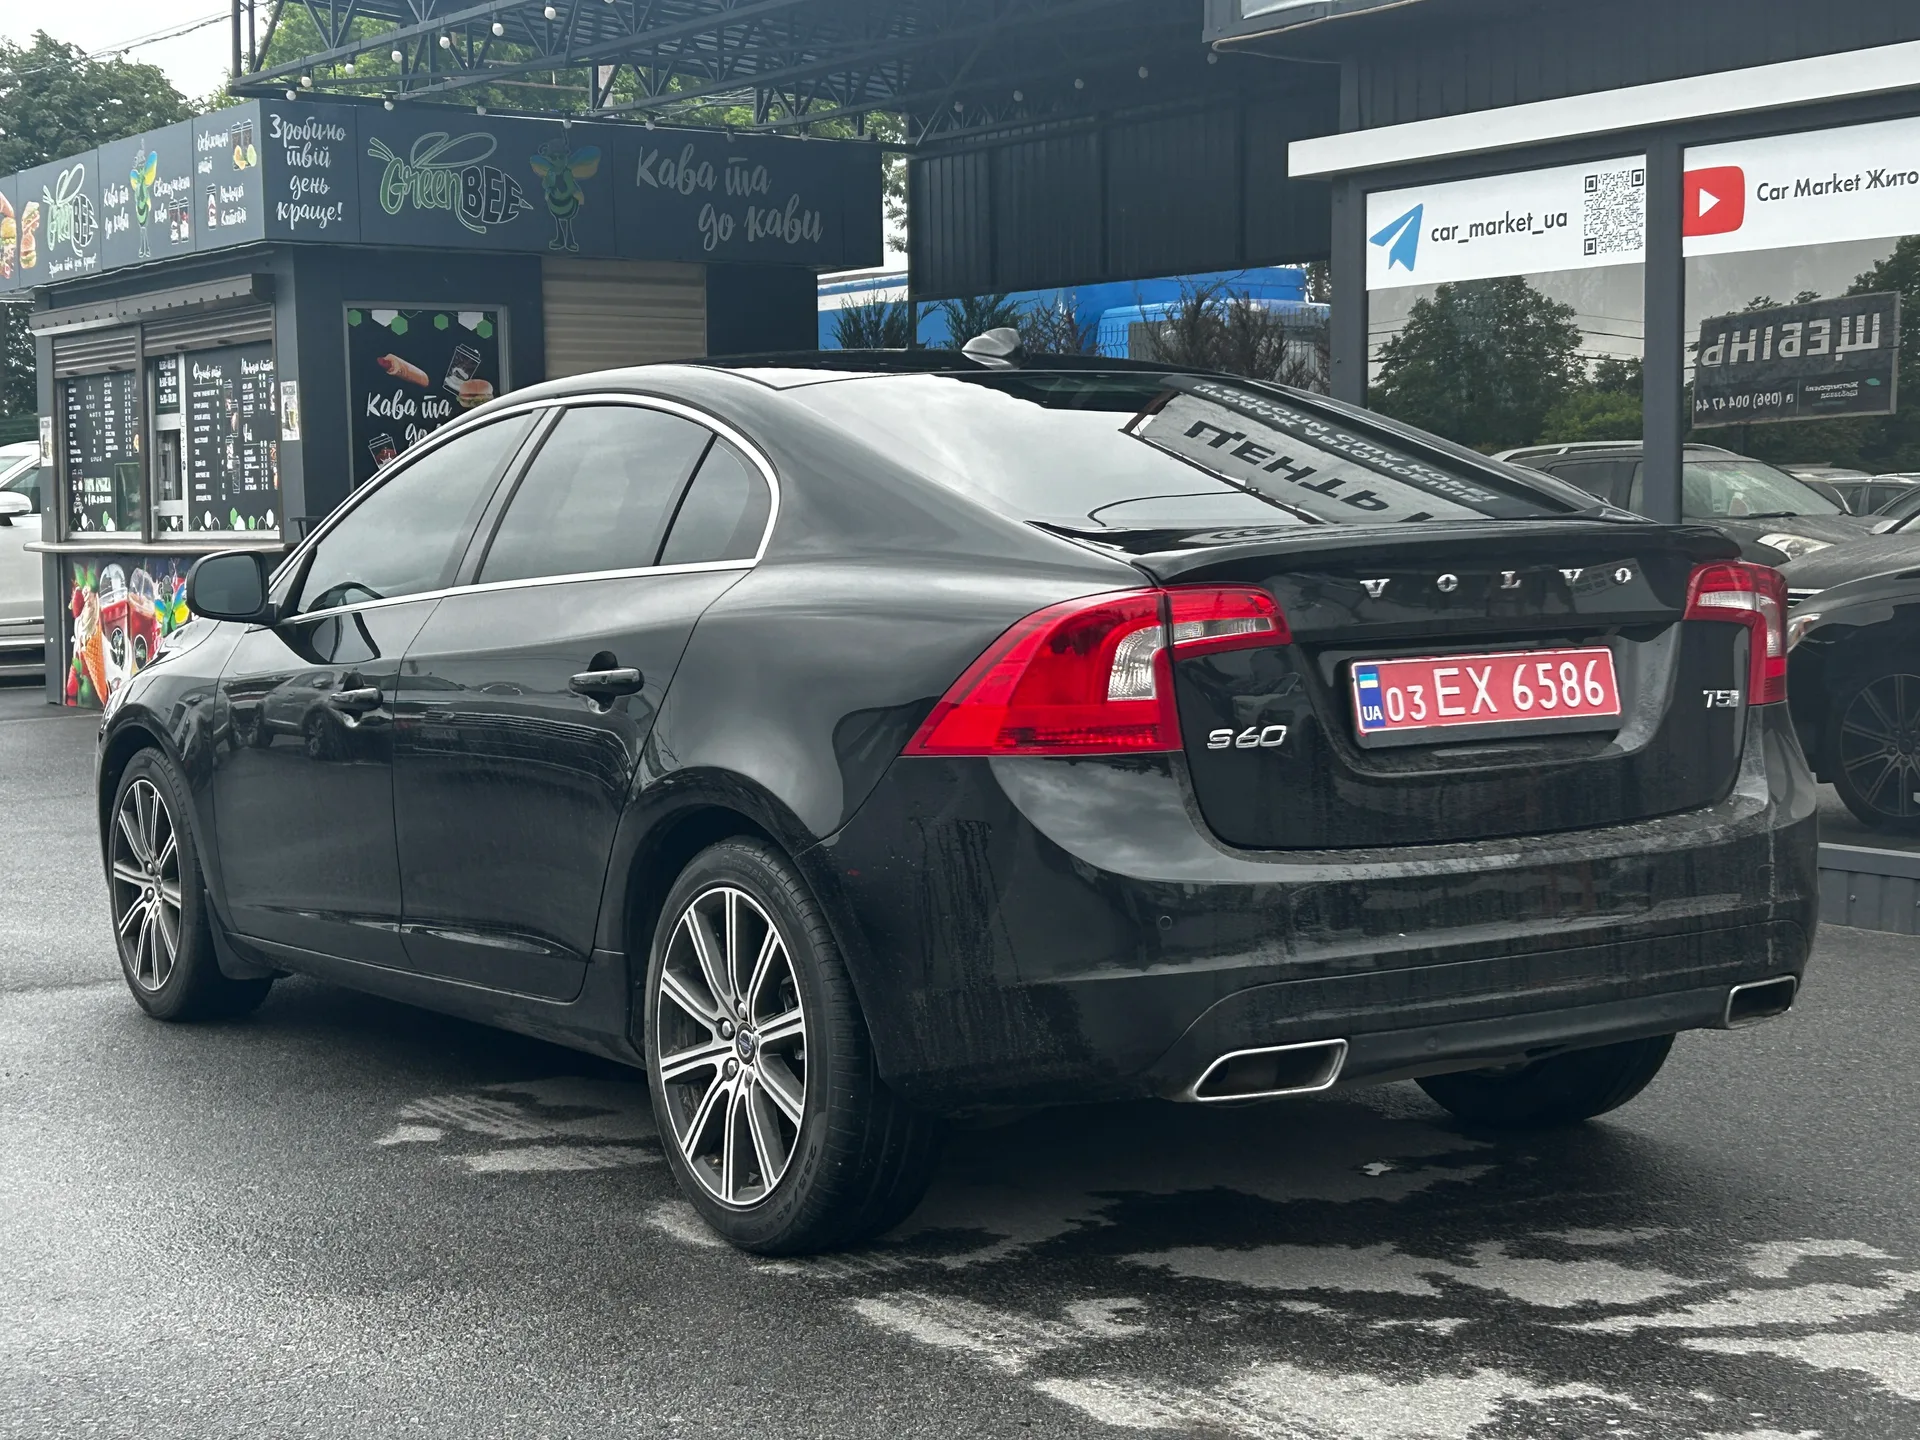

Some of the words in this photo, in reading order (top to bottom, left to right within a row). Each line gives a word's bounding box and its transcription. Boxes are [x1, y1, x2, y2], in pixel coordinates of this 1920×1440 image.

[287, 141, 331, 168] твій
[636, 143, 717, 195] Кава
[724, 157, 772, 197] та
[290, 175, 330, 200] день
[1757, 182, 1789, 202] Car
[1793, 173, 1861, 198] Market
[276, 202, 343, 230] краще!
[699, 203, 736, 251] до
[744, 194, 823, 243] кави
[1431, 211, 1568, 243] car_market_ua
[366, 389, 418, 421] Кава
[422, 395, 452, 419] та
[1360, 567, 1632, 598] VOLVO
[1386, 684, 1427, 722] 03
[1512, 660, 1604, 711] 6586
[1363, 704, 1383, 721] UA
[1206, 724, 1287, 749] S60
